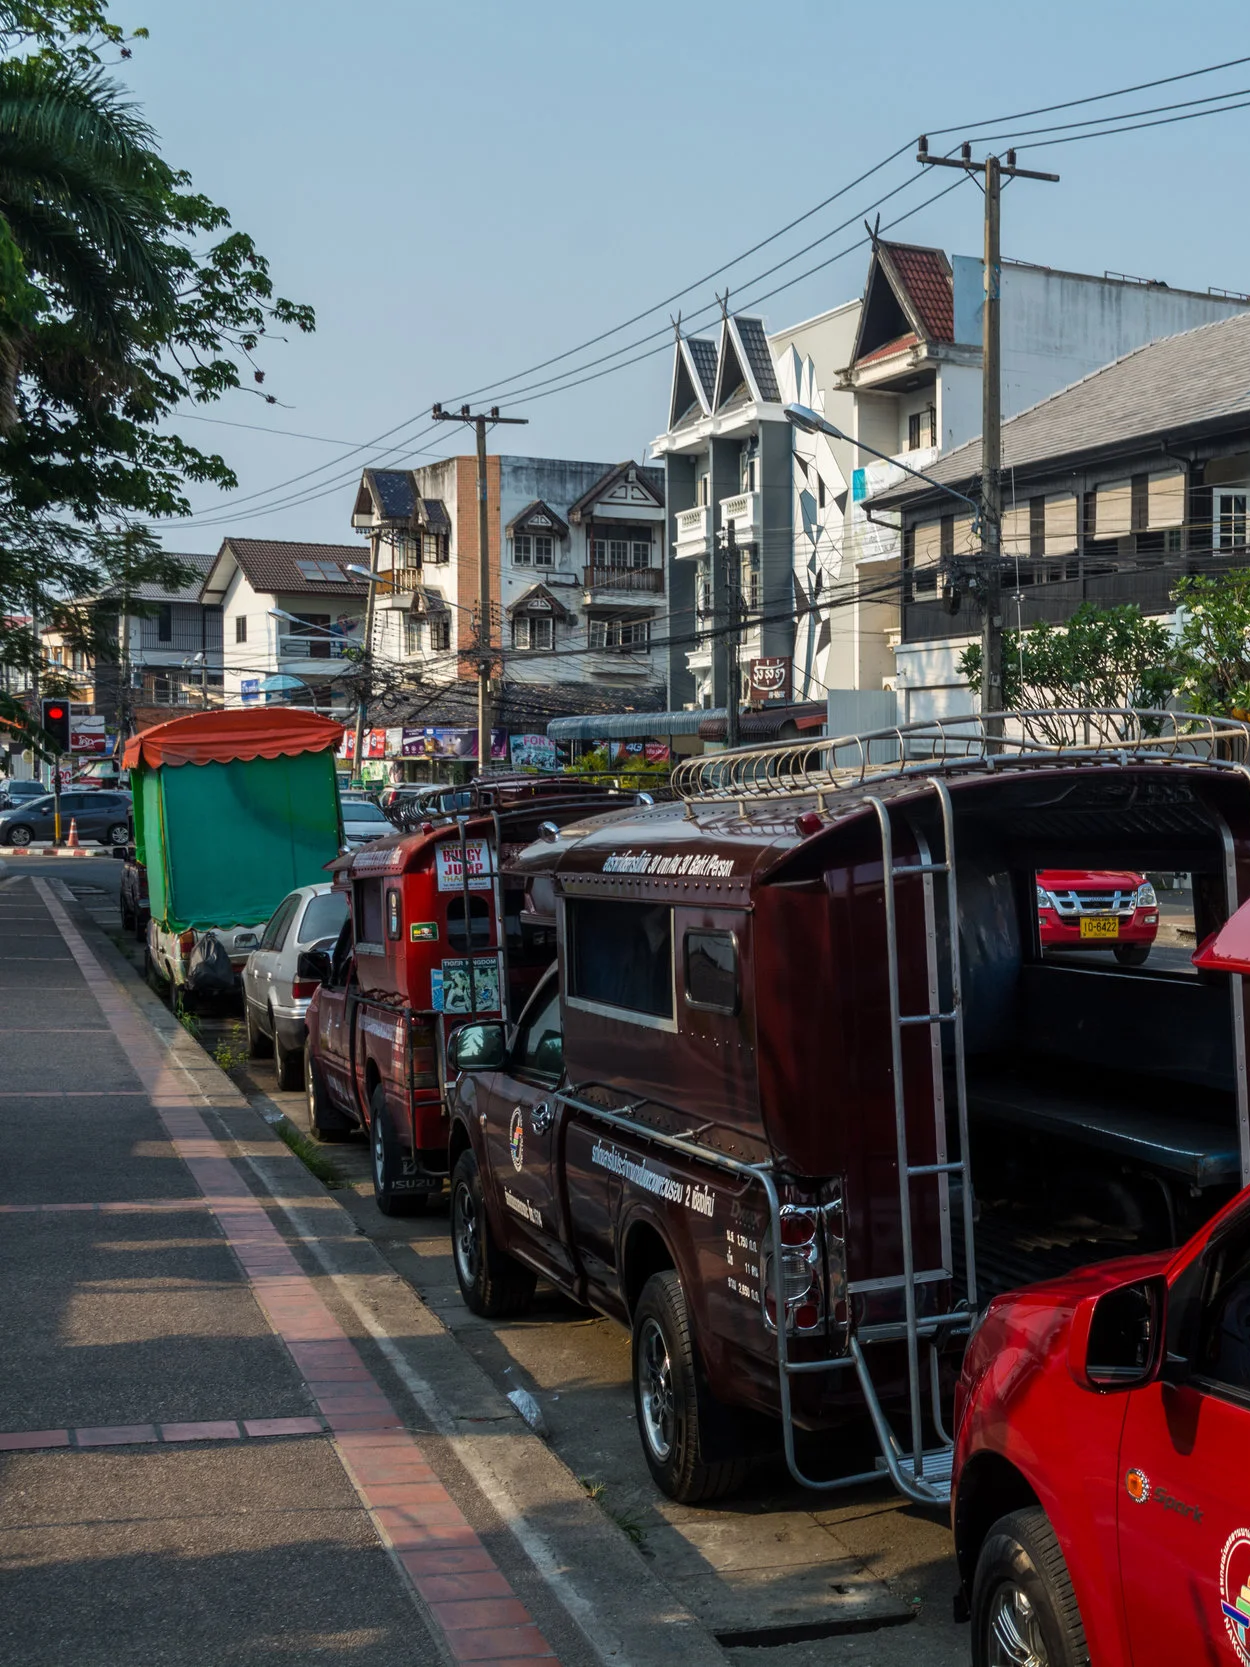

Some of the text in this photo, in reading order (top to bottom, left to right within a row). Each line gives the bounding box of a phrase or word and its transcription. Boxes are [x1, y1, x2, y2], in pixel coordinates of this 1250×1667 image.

[523, 736, 546, 746] FOR
[626, 743, 643, 752] 4G
[1084, 921, 1117, 932] 10-6422
[391, 1178, 436, 1189] ISUZU
[684, 1184, 696, 1207] 2
[1153, 1486, 1204, 1524] Spark
